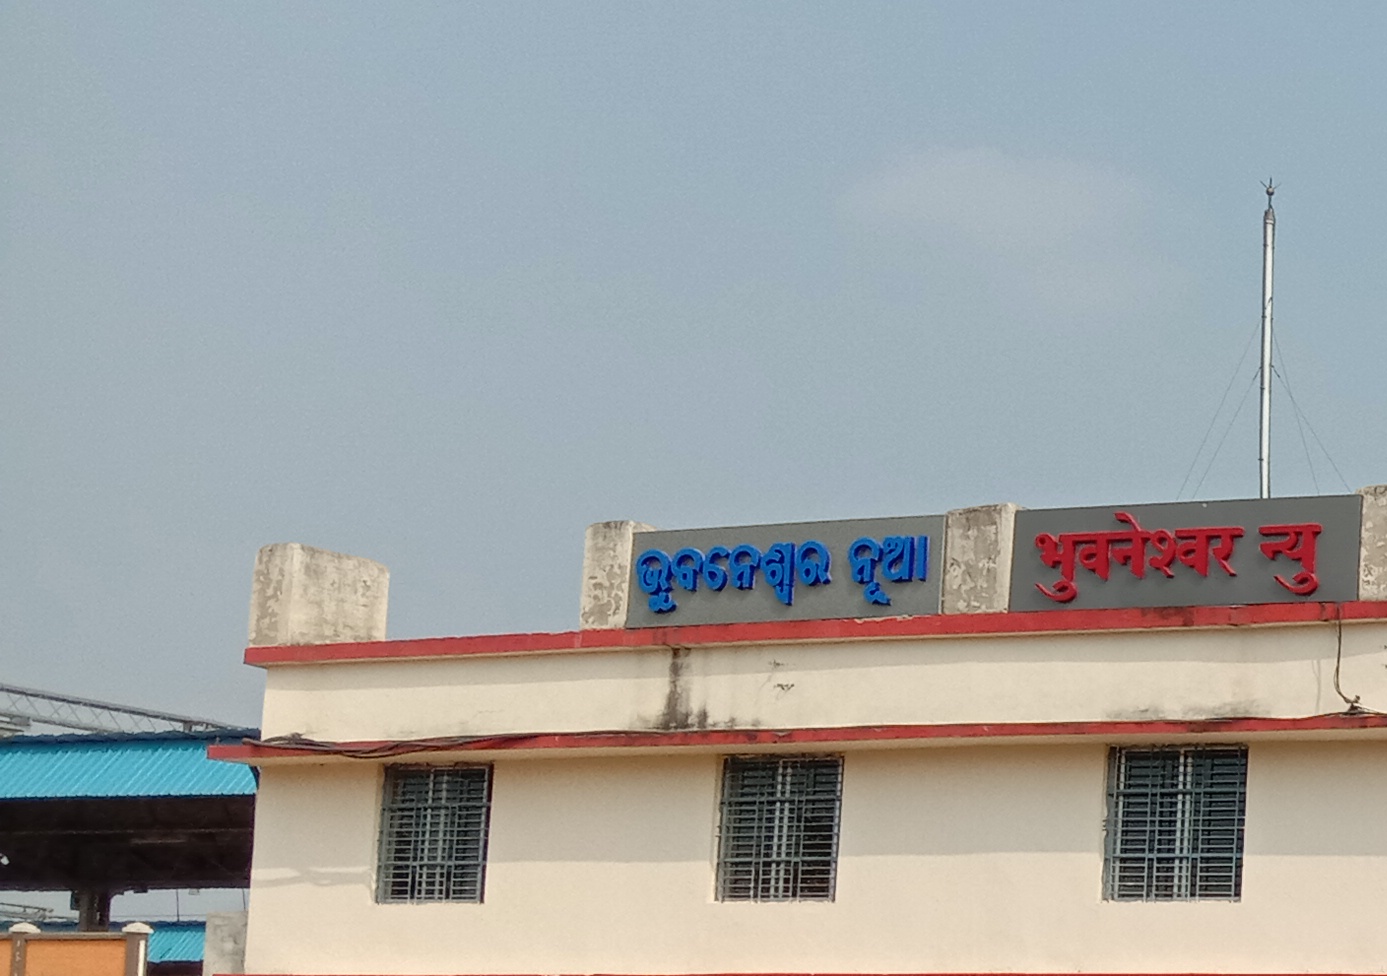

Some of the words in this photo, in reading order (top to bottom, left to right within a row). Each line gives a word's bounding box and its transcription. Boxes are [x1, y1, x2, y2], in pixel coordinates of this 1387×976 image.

[847, 534, 931, 606] ନୂଆ
[1034, 511, 1245, 604] भुवनेश्वर
[1258, 522, 1324, 596] न्यु
